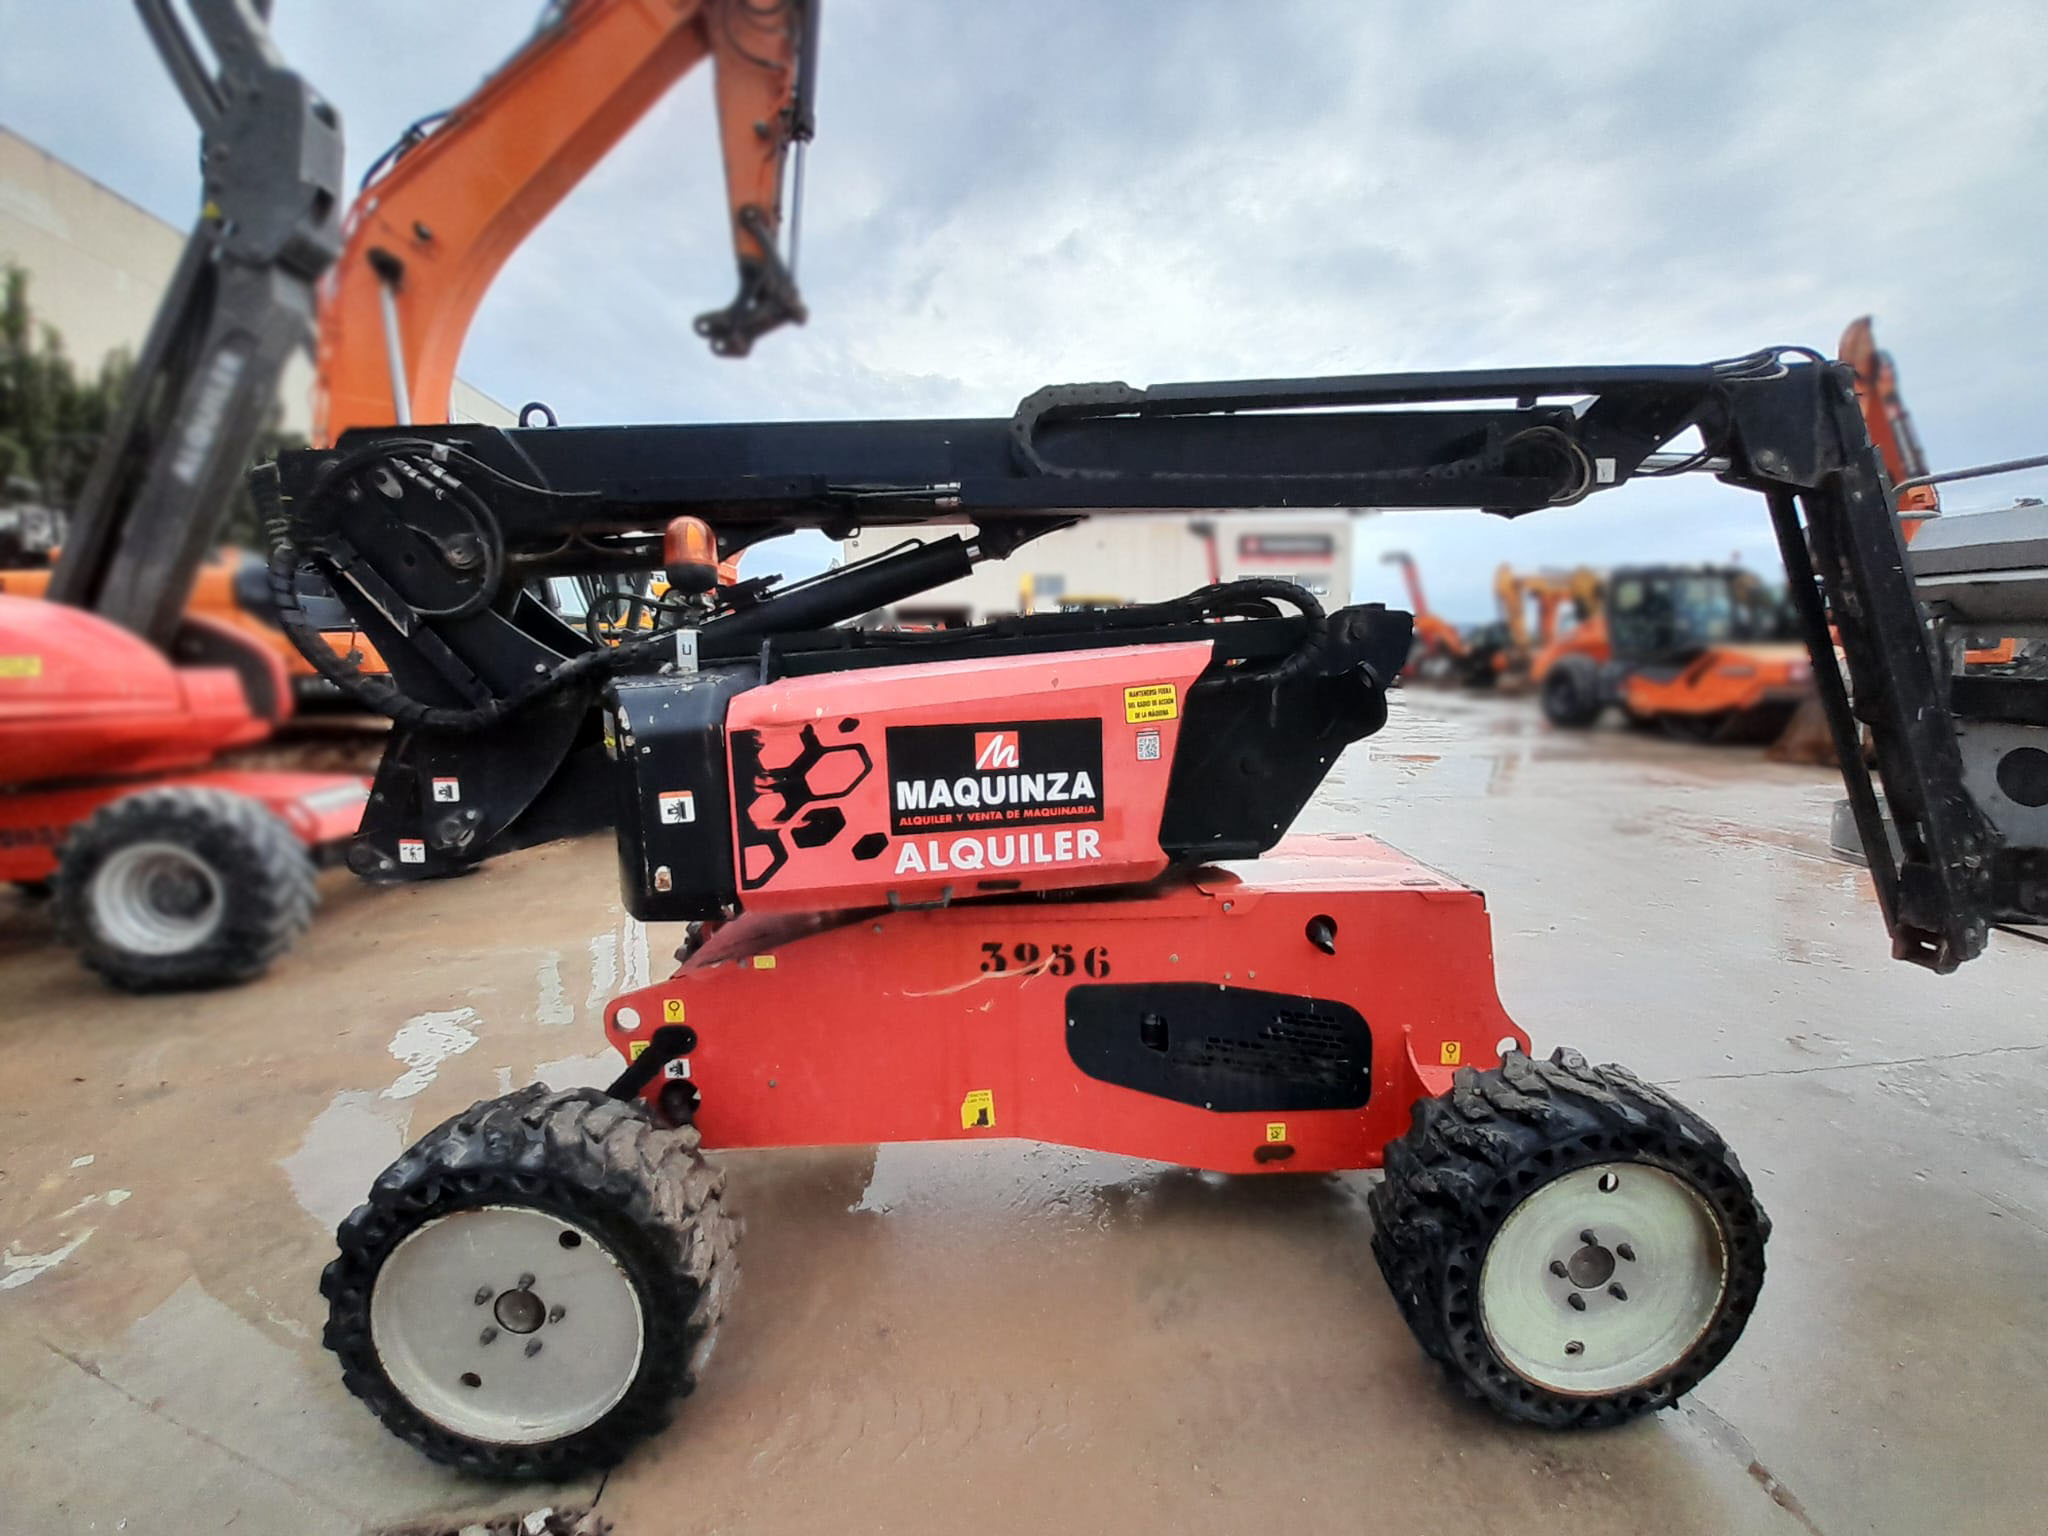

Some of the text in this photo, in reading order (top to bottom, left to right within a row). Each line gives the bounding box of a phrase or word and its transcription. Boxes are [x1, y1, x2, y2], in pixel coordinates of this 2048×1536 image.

[896, 771, 1096, 811] MAQUINZA
[899, 805, 1096, 827] ALQUILER Y VENTA DE MAQUINARIA
[894, 829, 1101, 875] ALQUILER
[980, 942, 1111, 979] 3956
